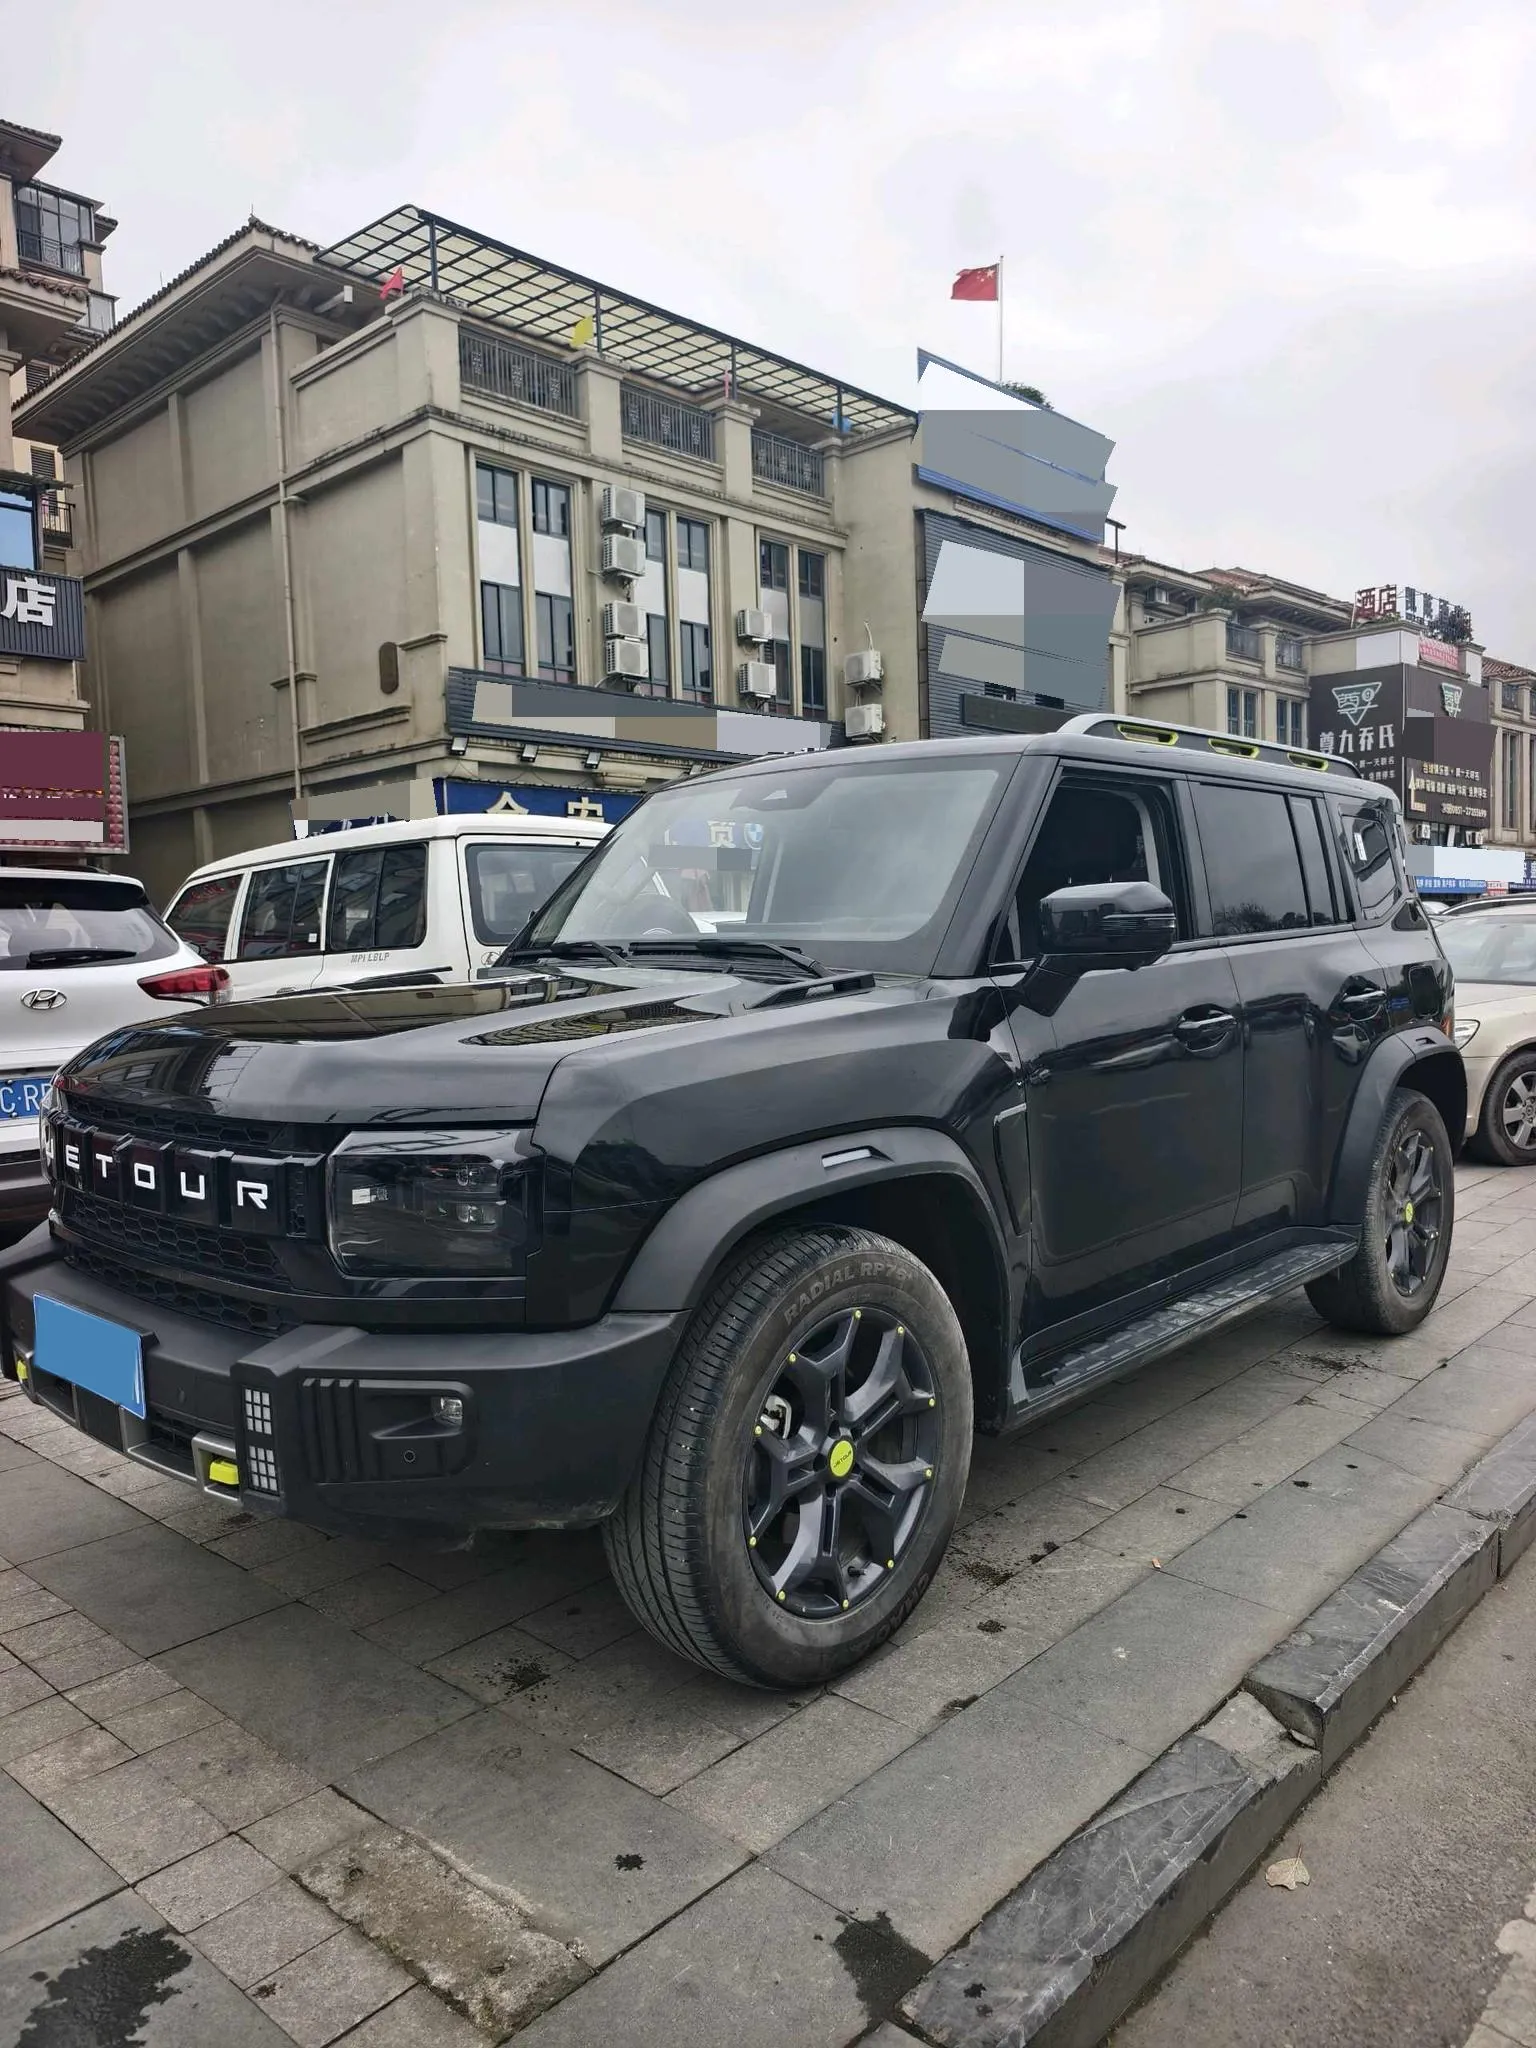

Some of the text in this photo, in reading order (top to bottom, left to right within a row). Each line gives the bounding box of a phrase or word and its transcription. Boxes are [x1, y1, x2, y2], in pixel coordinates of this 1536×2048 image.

[0, 576, 56, 627] 店
[1355, 585, 1397, 619] 酒店
[1319, 723, 1395, 755] 尊九乔氏
[783, 1265, 856, 1326] RADIAL
